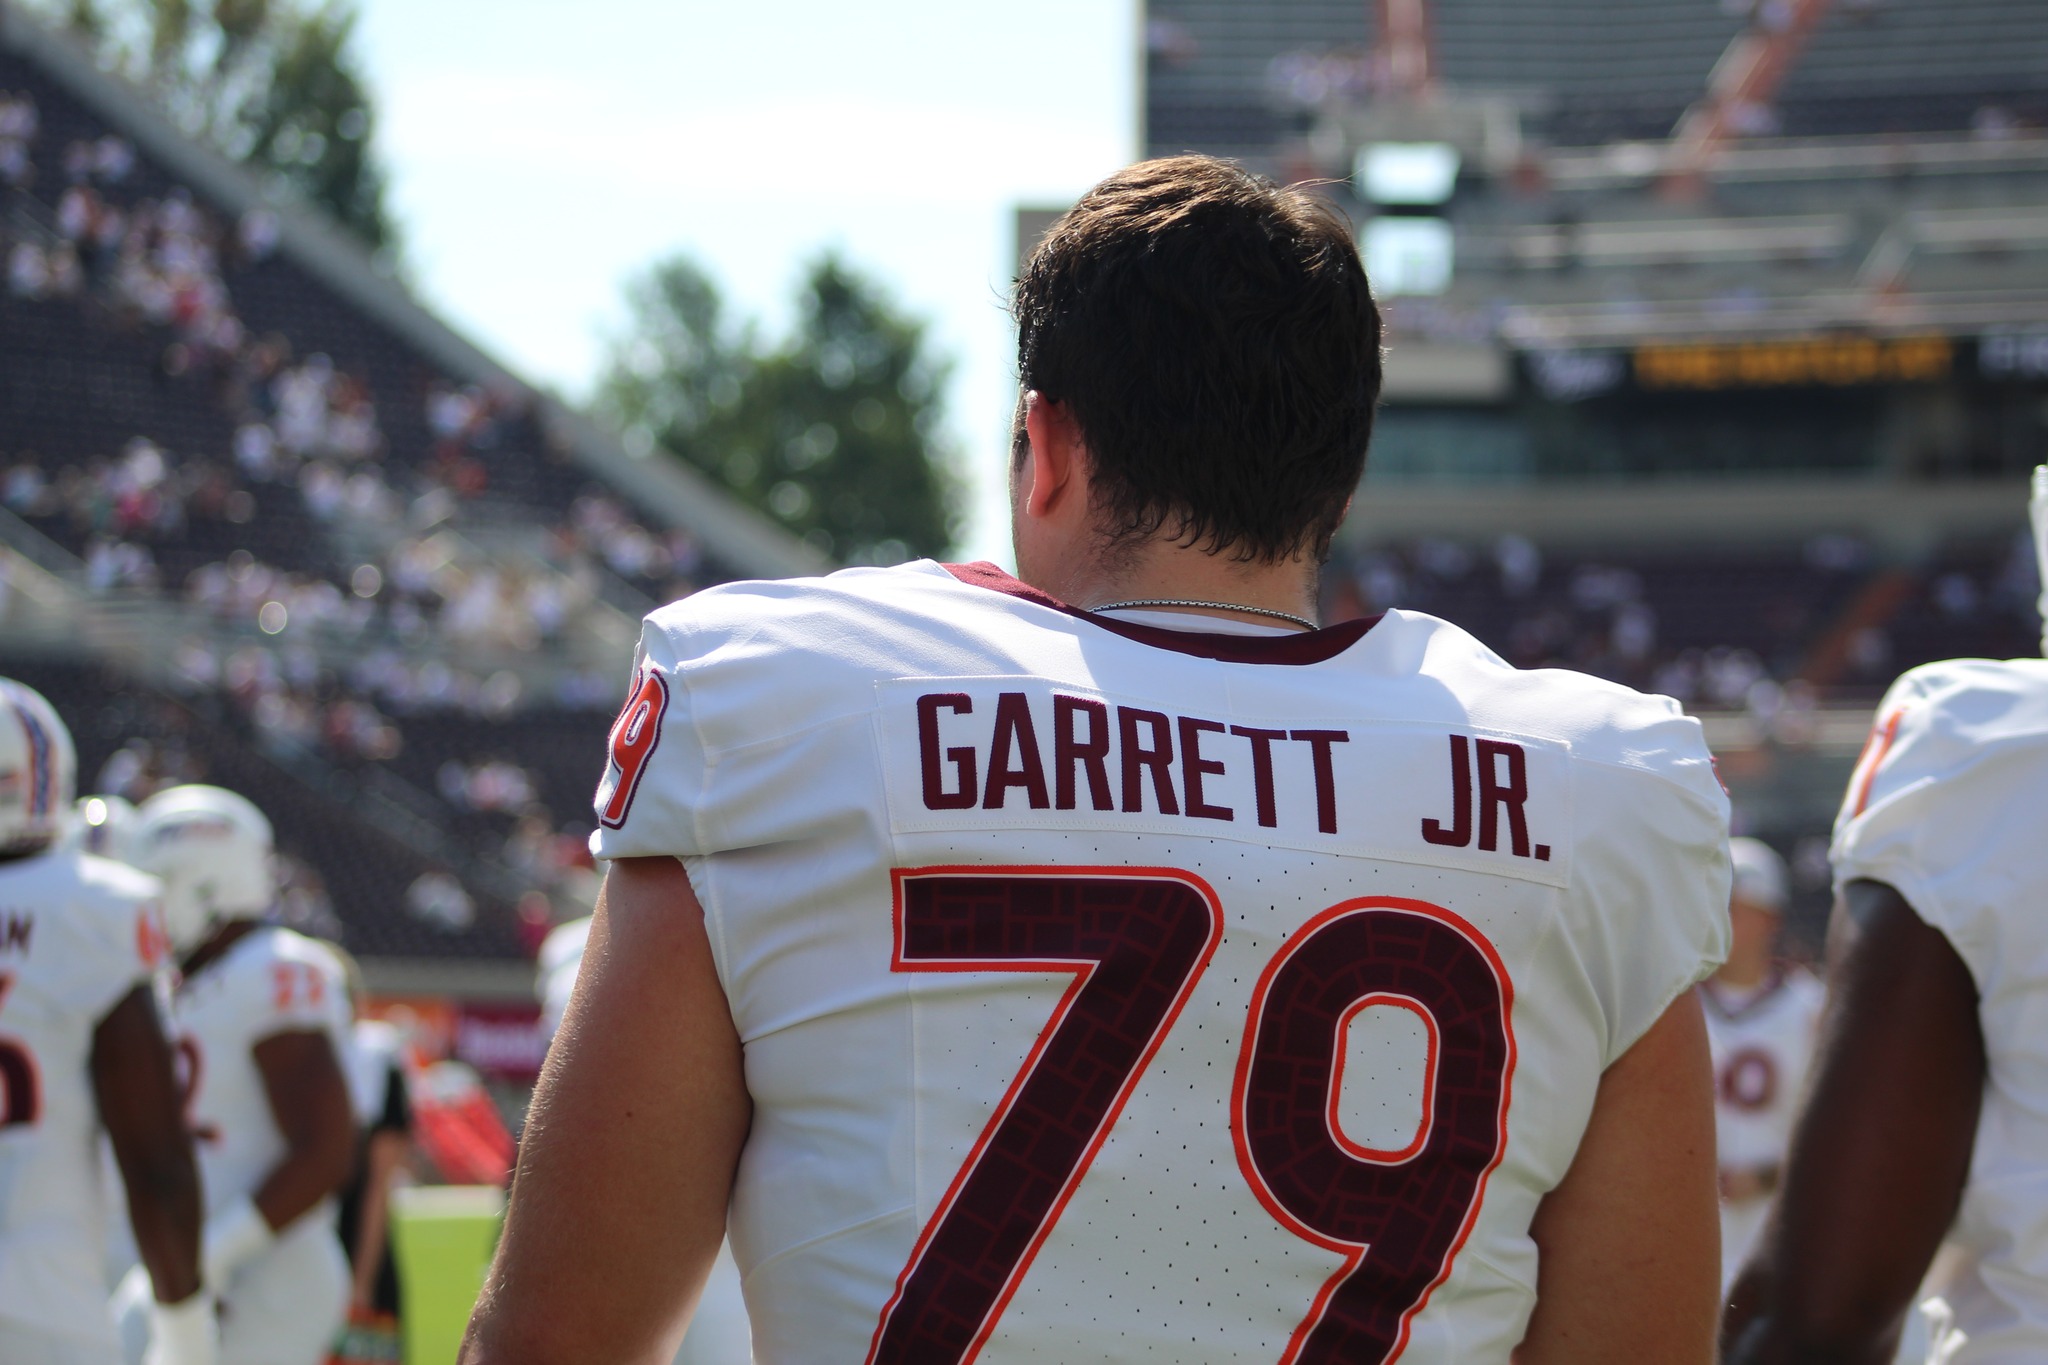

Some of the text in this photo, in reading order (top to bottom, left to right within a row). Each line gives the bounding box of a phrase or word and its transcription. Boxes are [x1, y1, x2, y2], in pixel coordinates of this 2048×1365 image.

[916, 691, 1551, 862] GARRETT JR.
[864, 865, 1517, 1365] 79
